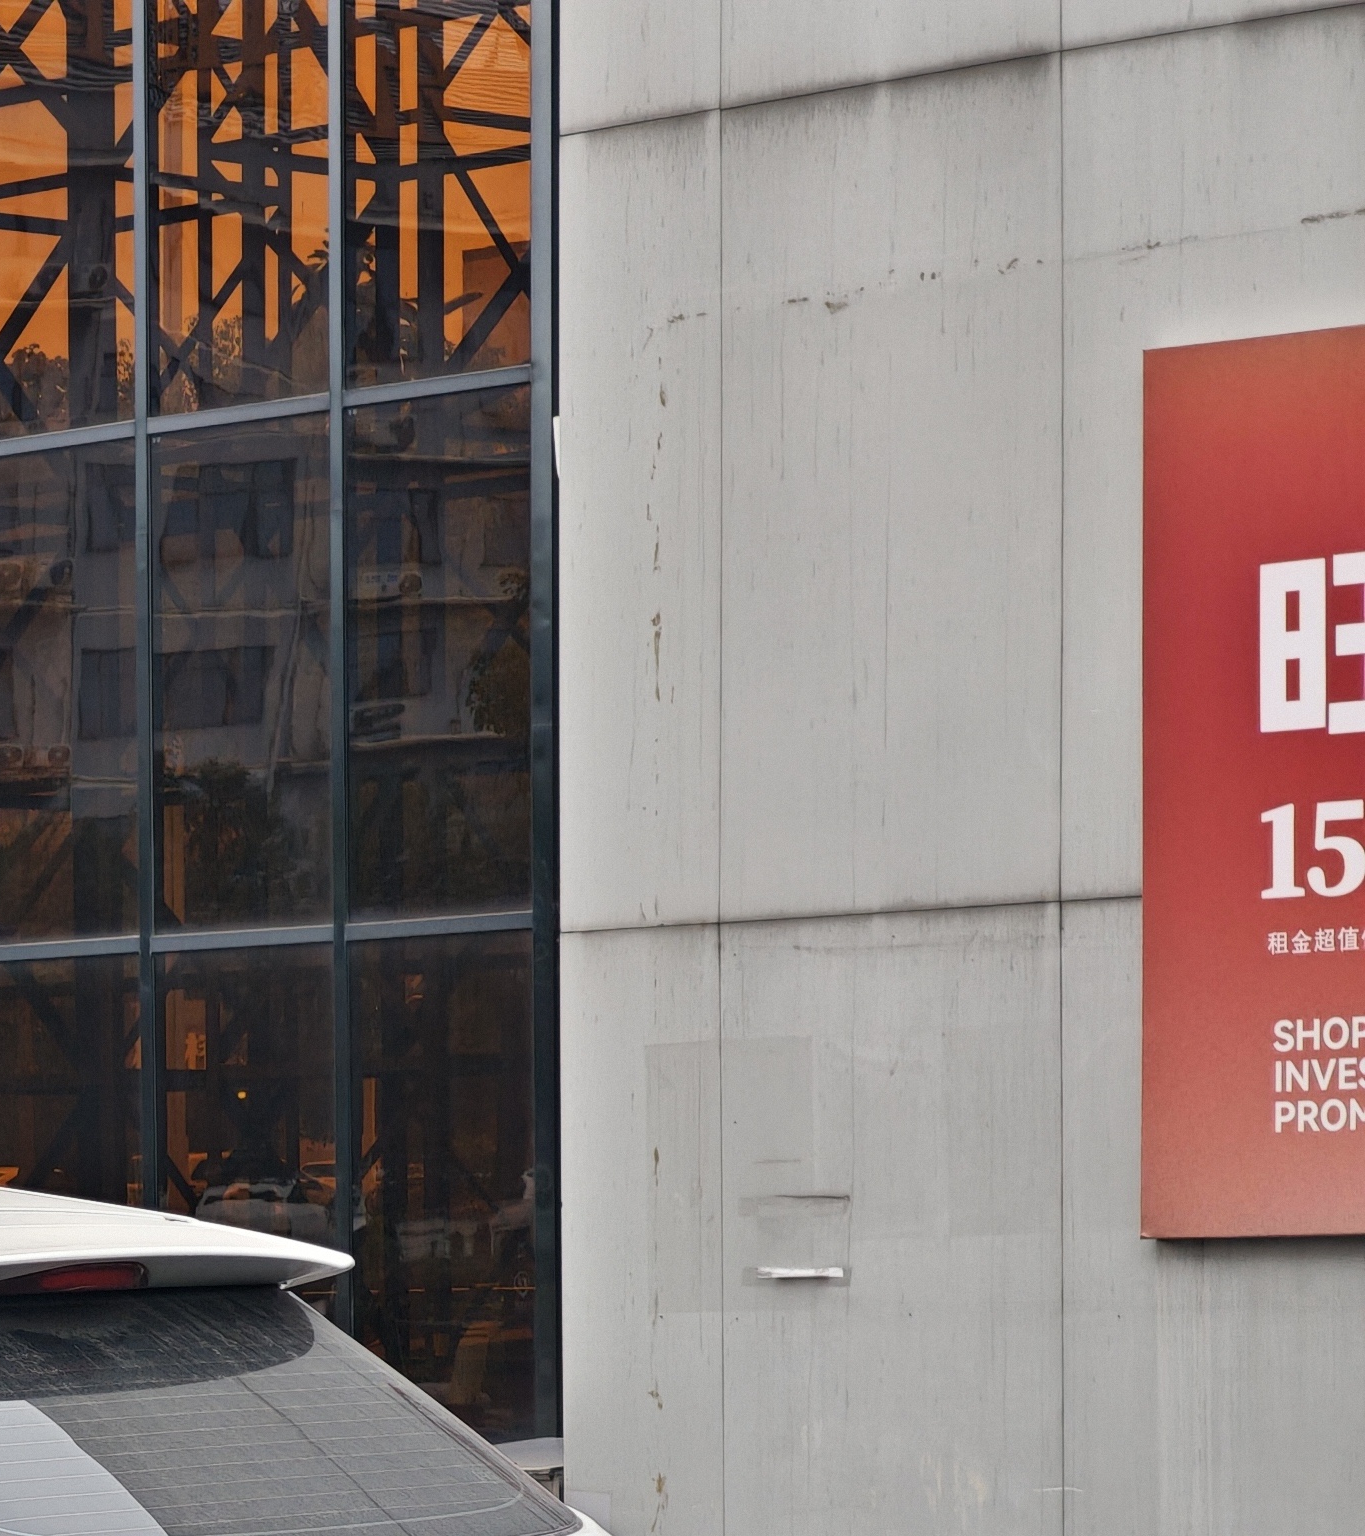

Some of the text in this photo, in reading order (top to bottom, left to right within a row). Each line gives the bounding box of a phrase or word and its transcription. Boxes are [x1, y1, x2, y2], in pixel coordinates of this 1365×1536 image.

[1261, 799, 1365, 899] 15
[1267, 926, 1365, 956] 租金超值
[1273, 1016, 1365, 1052] SHOP
